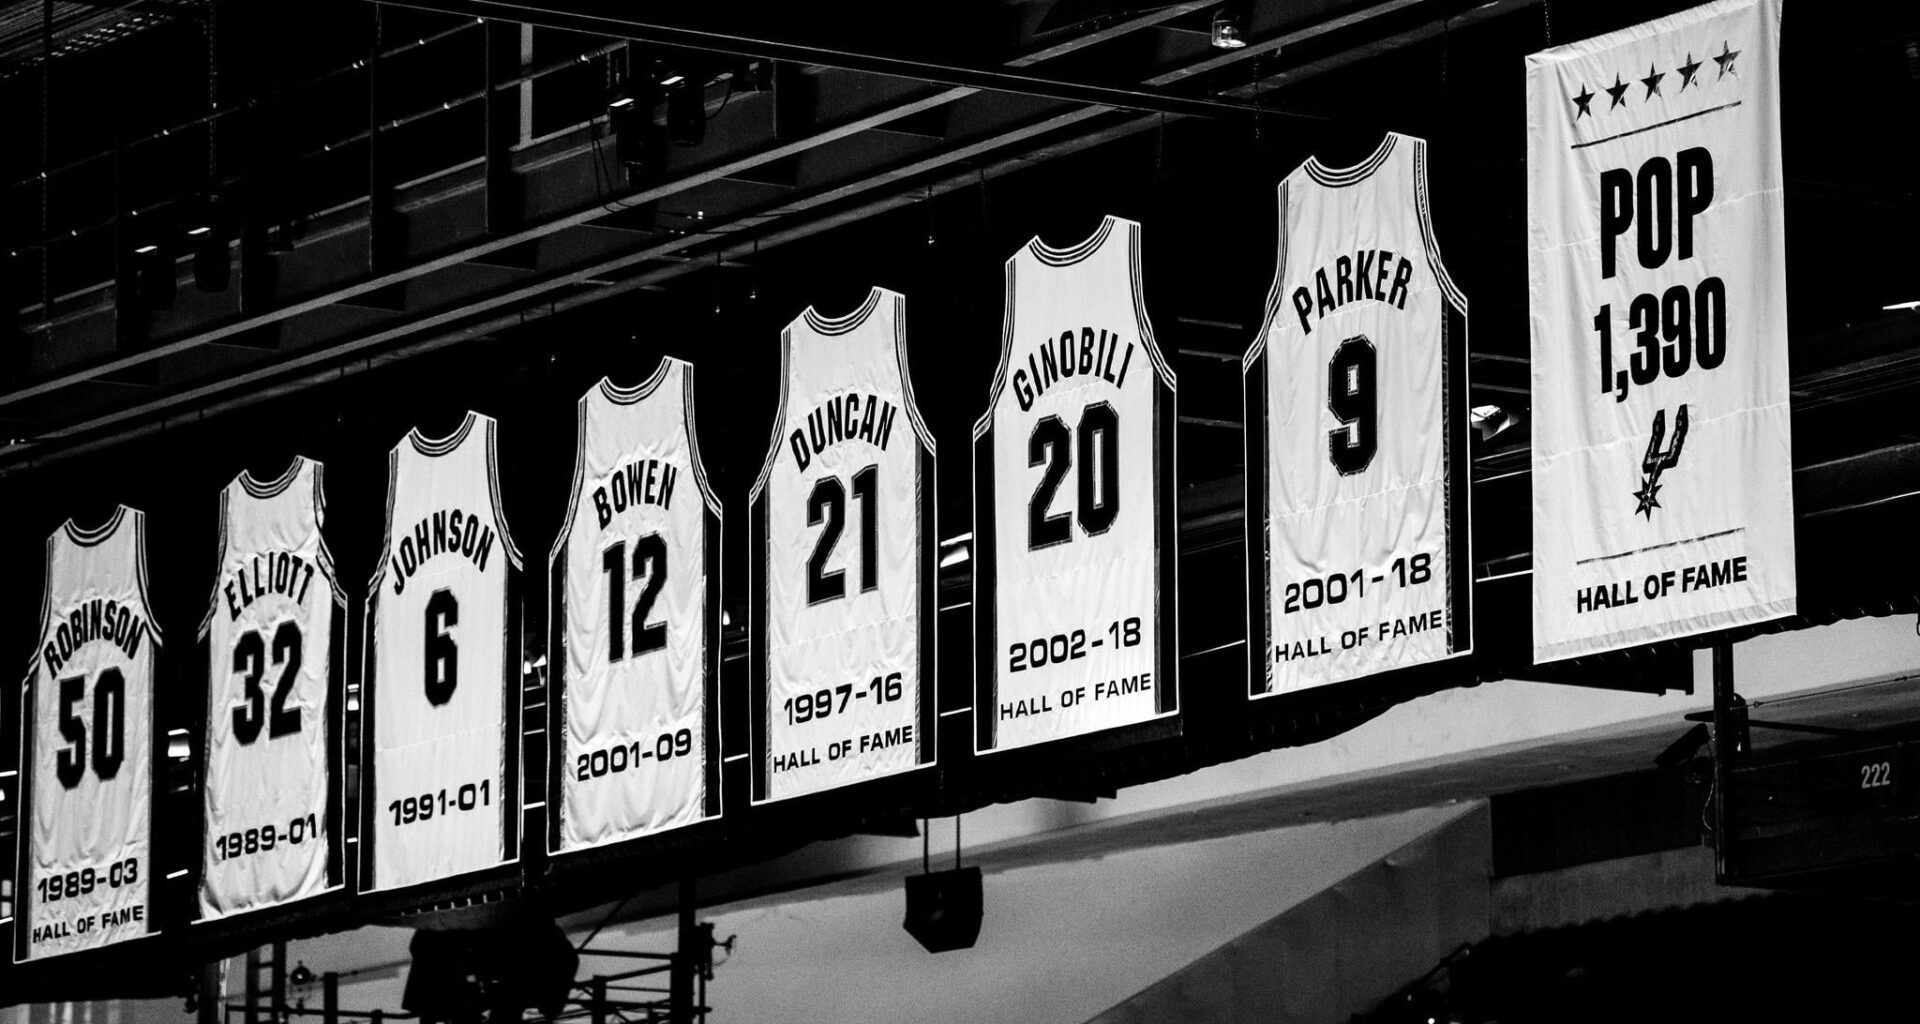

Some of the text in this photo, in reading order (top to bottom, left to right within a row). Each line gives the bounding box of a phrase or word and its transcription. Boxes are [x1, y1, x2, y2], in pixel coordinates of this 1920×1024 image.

[1600, 146, 1715, 280] POP
[1291, 249, 1413, 336] PARKER
[1012, 327, 1135, 412] GINOBILI
[1593, 276, 1727, 404] 1,390
[790, 393, 897, 472] DUNCAN
[1328, 334, 1378, 478] 9
[592, 459, 677, 531] BOWEN
[1027, 400, 1120, 552] 20
[391, 509, 494, 596] JOHNSON
[806, 463, 879, 607] 21
[224, 551, 314, 622] ELLIOTT
[602, 530, 668, 664] 12
[1284, 552, 1432, 613] 2001-18
[1576, 556, 1748, 614] HALL OF FAME
[42, 598, 145, 679] ROBINSON
[424, 586, 458, 709] 6
[1009, 616, 1142, 672] 2002-18
[1275, 609, 1443, 663] HALL OF FAME
[232, 619, 303, 746] 32
[783, 672, 903, 726] 1997-16
[1000, 672, 1152, 721] HALL OF FAME
[57, 666, 125, 790] 50
[577, 728, 691, 782] 2001-09
[773, 725, 913, 773] HALL OF FAME
[388, 779, 490, 826] 1991-01
[1861, 762, 1891, 789] 222
[216, 813, 317, 860] 1989-01
[37, 857, 138, 903] 1989-03
[33, 905, 144, 943] HALL OF FAME
